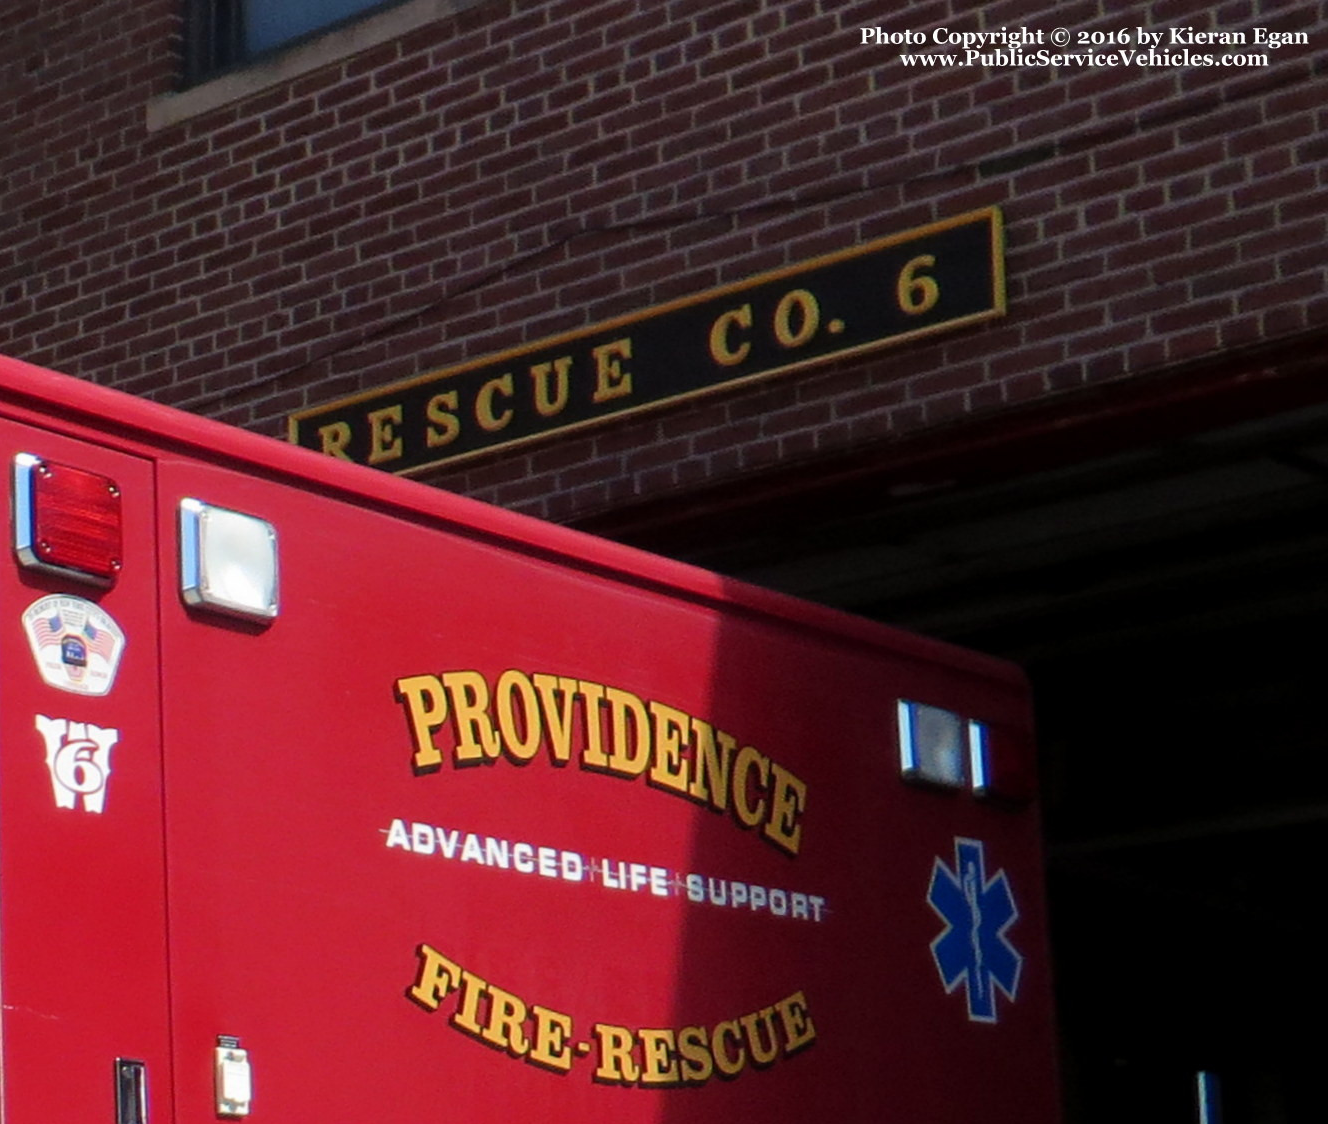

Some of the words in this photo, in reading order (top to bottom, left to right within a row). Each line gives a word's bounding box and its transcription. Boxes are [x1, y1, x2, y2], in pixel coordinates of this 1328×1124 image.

[318, 337, 634, 465] RESCUE
[709, 288, 845, 366] CO.
[896, 254, 941, 316] 6
[394, 669, 808, 857] PROVIDENCE
[385, 818, 584, 882] ADVANCED
[600, 858, 669, 897] LIFE
[685, 873, 826, 922] SUPPORT
[407, 943, 817, 1089] FIRE-RESCUE
